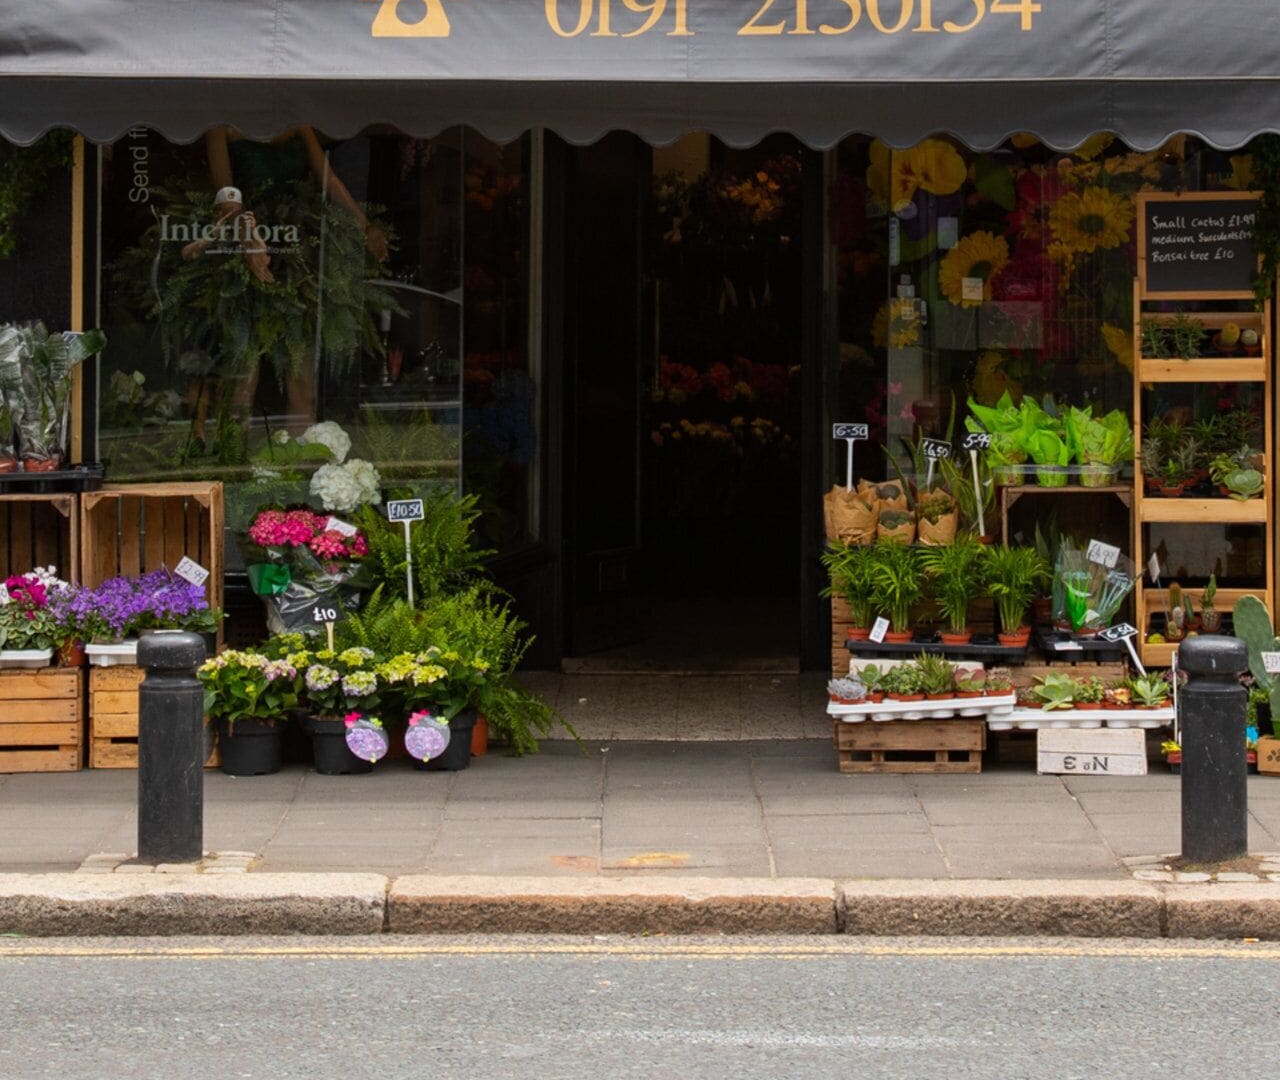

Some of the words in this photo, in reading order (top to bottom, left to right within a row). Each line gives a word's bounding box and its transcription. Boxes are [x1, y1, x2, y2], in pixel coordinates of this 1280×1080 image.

[128, 146, 149, 204] Send
[160, 214, 301, 243] Interflora
[1152, 216, 1186, 230] Small
[1214, 248, 1235, 260] £10
[313, 607, 337, 622] £10
